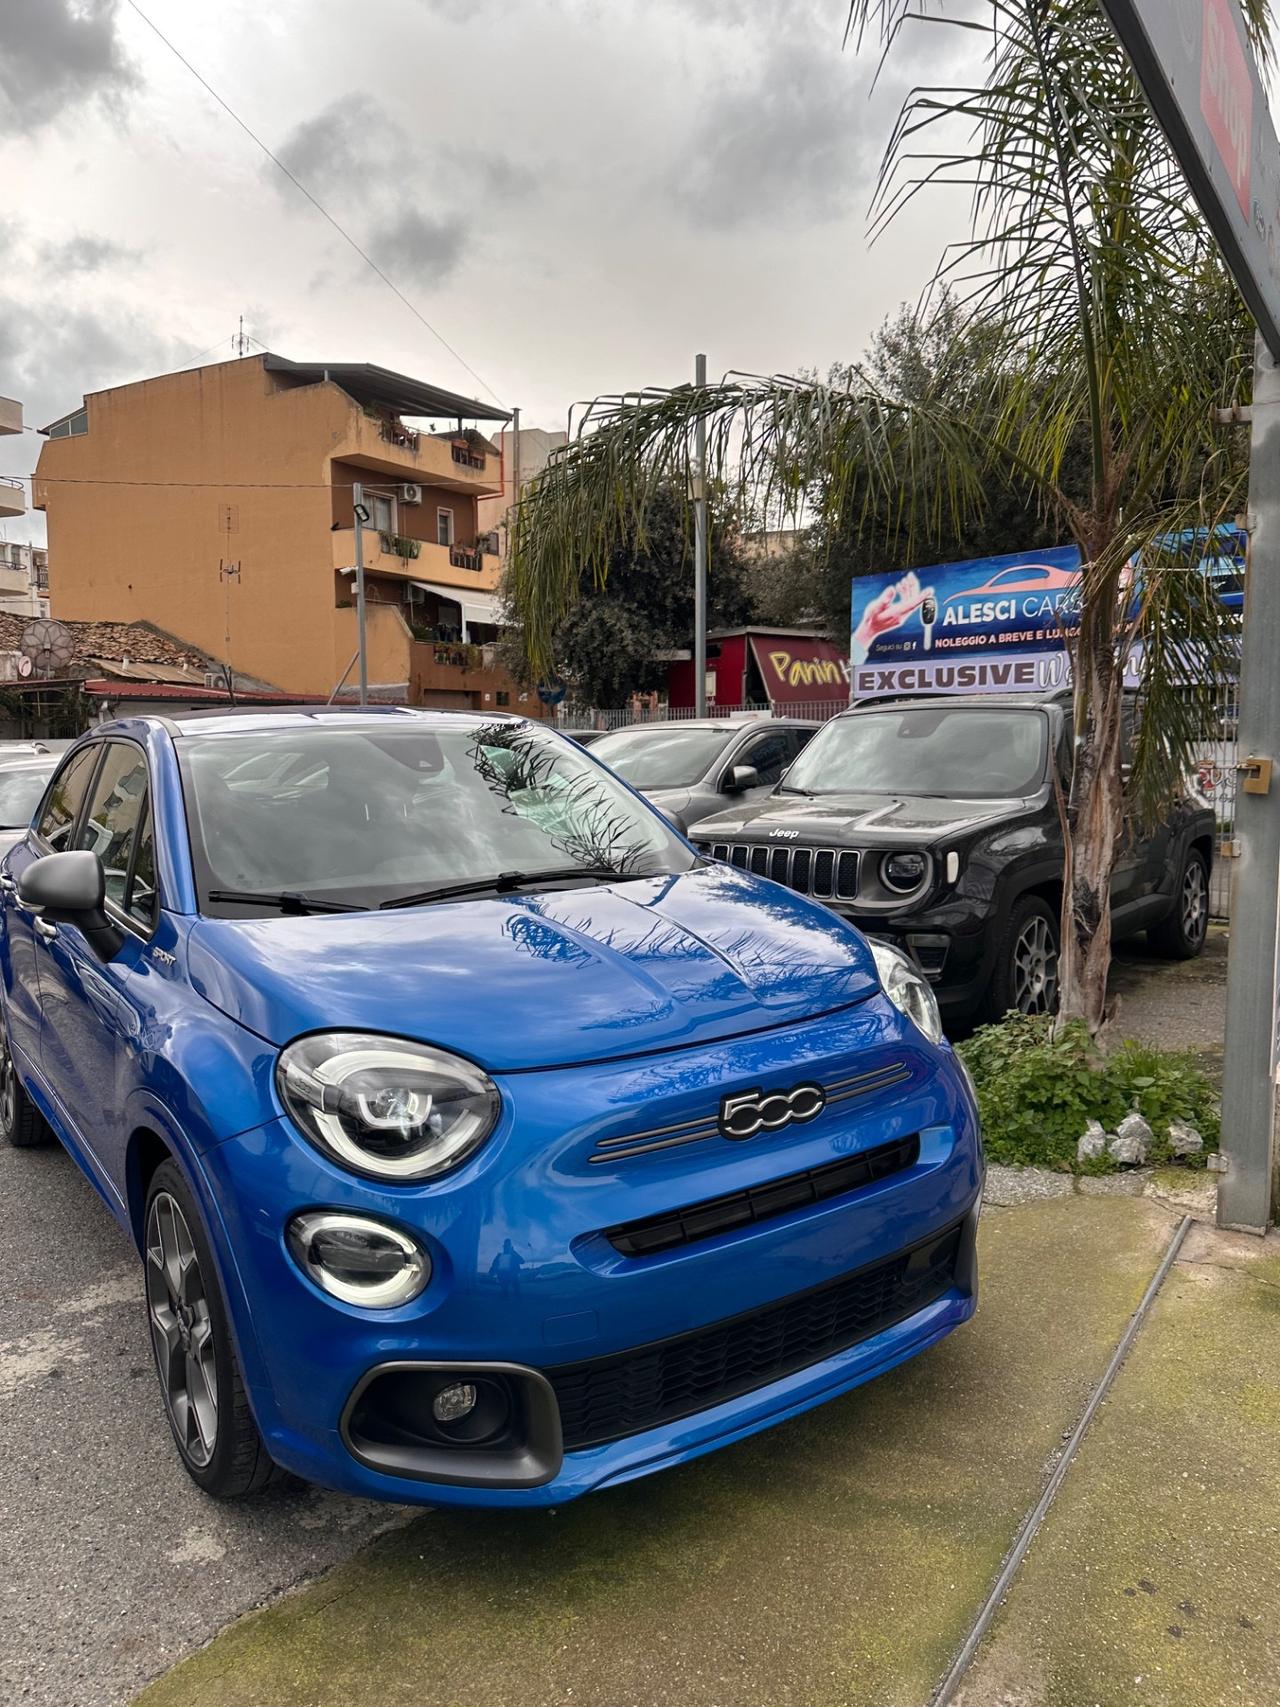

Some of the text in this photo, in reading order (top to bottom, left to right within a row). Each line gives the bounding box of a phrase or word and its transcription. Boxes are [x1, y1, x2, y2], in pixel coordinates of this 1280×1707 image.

[943, 591, 1083, 626] ALESCI CARS
[934, 634, 987, 648] NOLEGGIO
[988, 635, 996, 645] A
[999, 630, 1036, 643] BREVE
[1036, 629, 1044, 640] E
[858, 662, 1035, 692] EXCLUSIVE
[769, 828, 799, 839] Jeep
[153, 946, 176, 967] SPORT
[724, 1087, 823, 1135] 500
